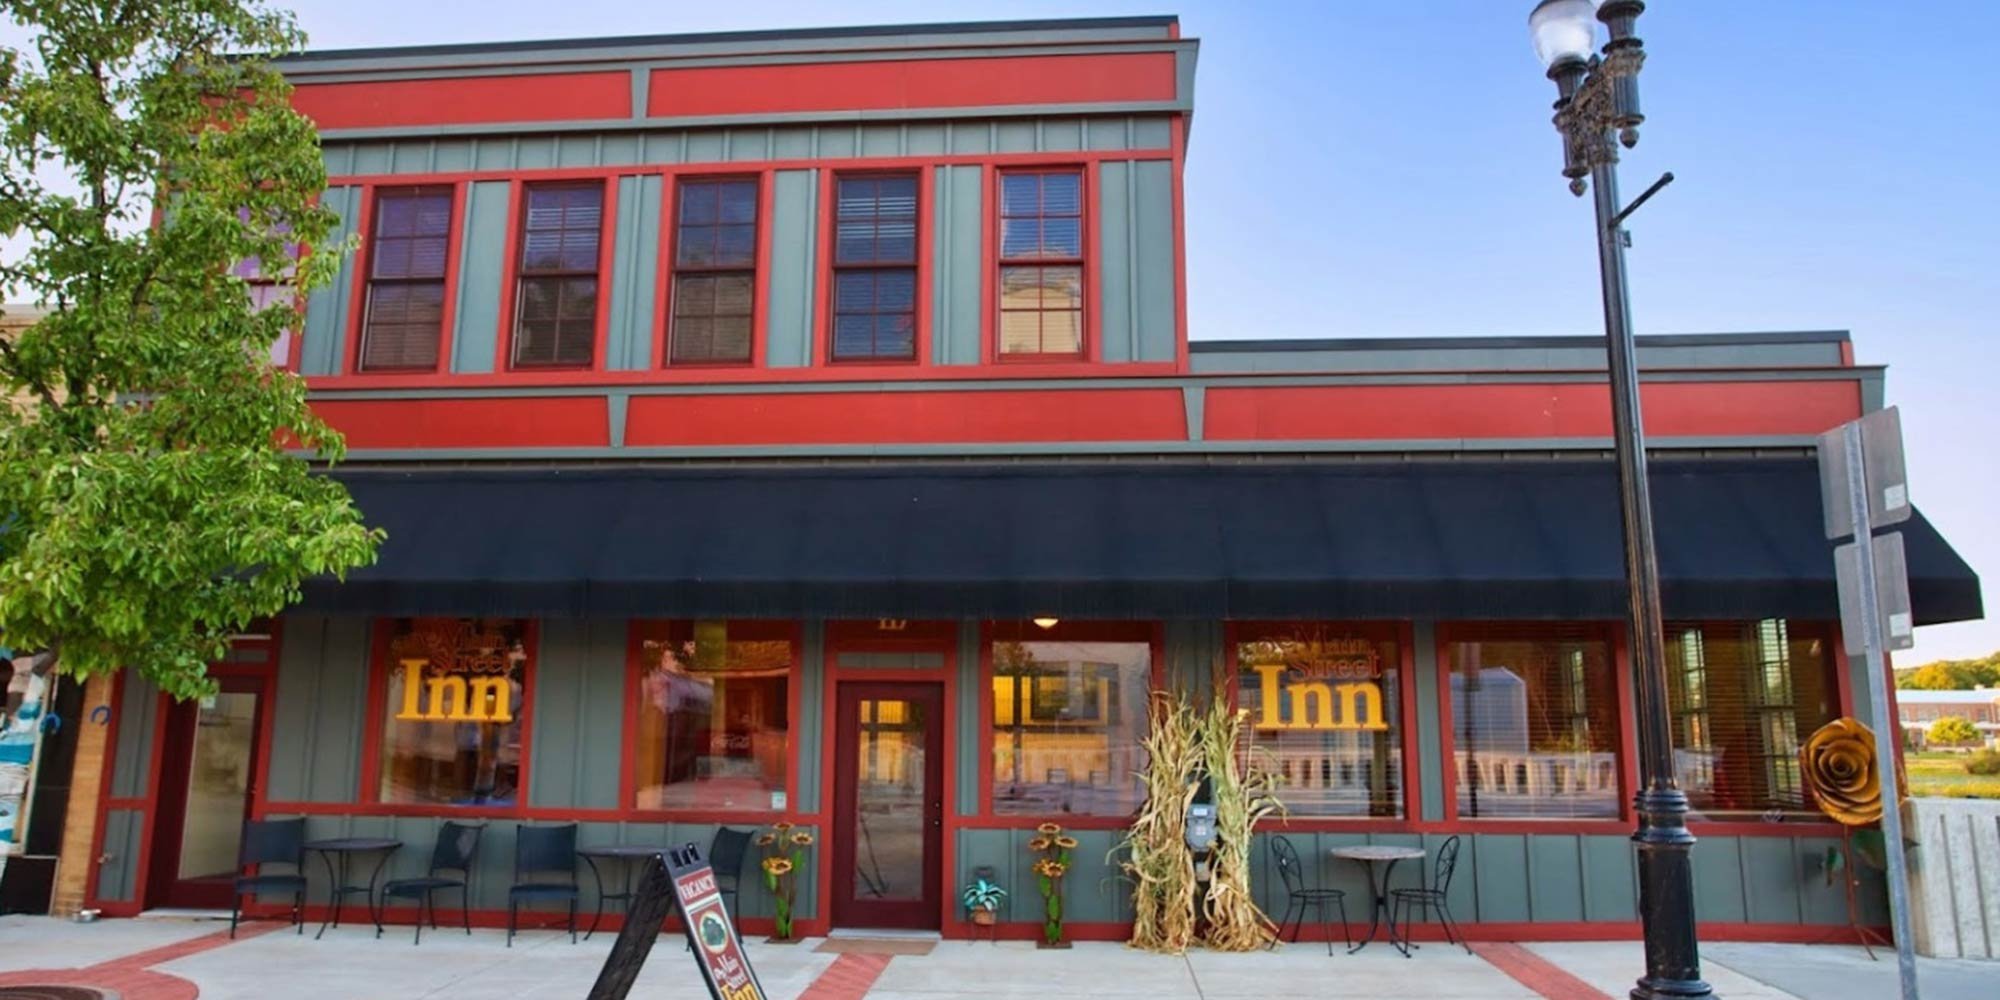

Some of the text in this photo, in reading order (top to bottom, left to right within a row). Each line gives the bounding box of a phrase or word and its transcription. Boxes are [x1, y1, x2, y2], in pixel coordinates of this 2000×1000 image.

[1288, 649, 1382, 680] Street
[396, 658, 513, 721] Inn
[1253, 665, 1388, 730] Inn
[679, 874, 715, 899] VACANCY
